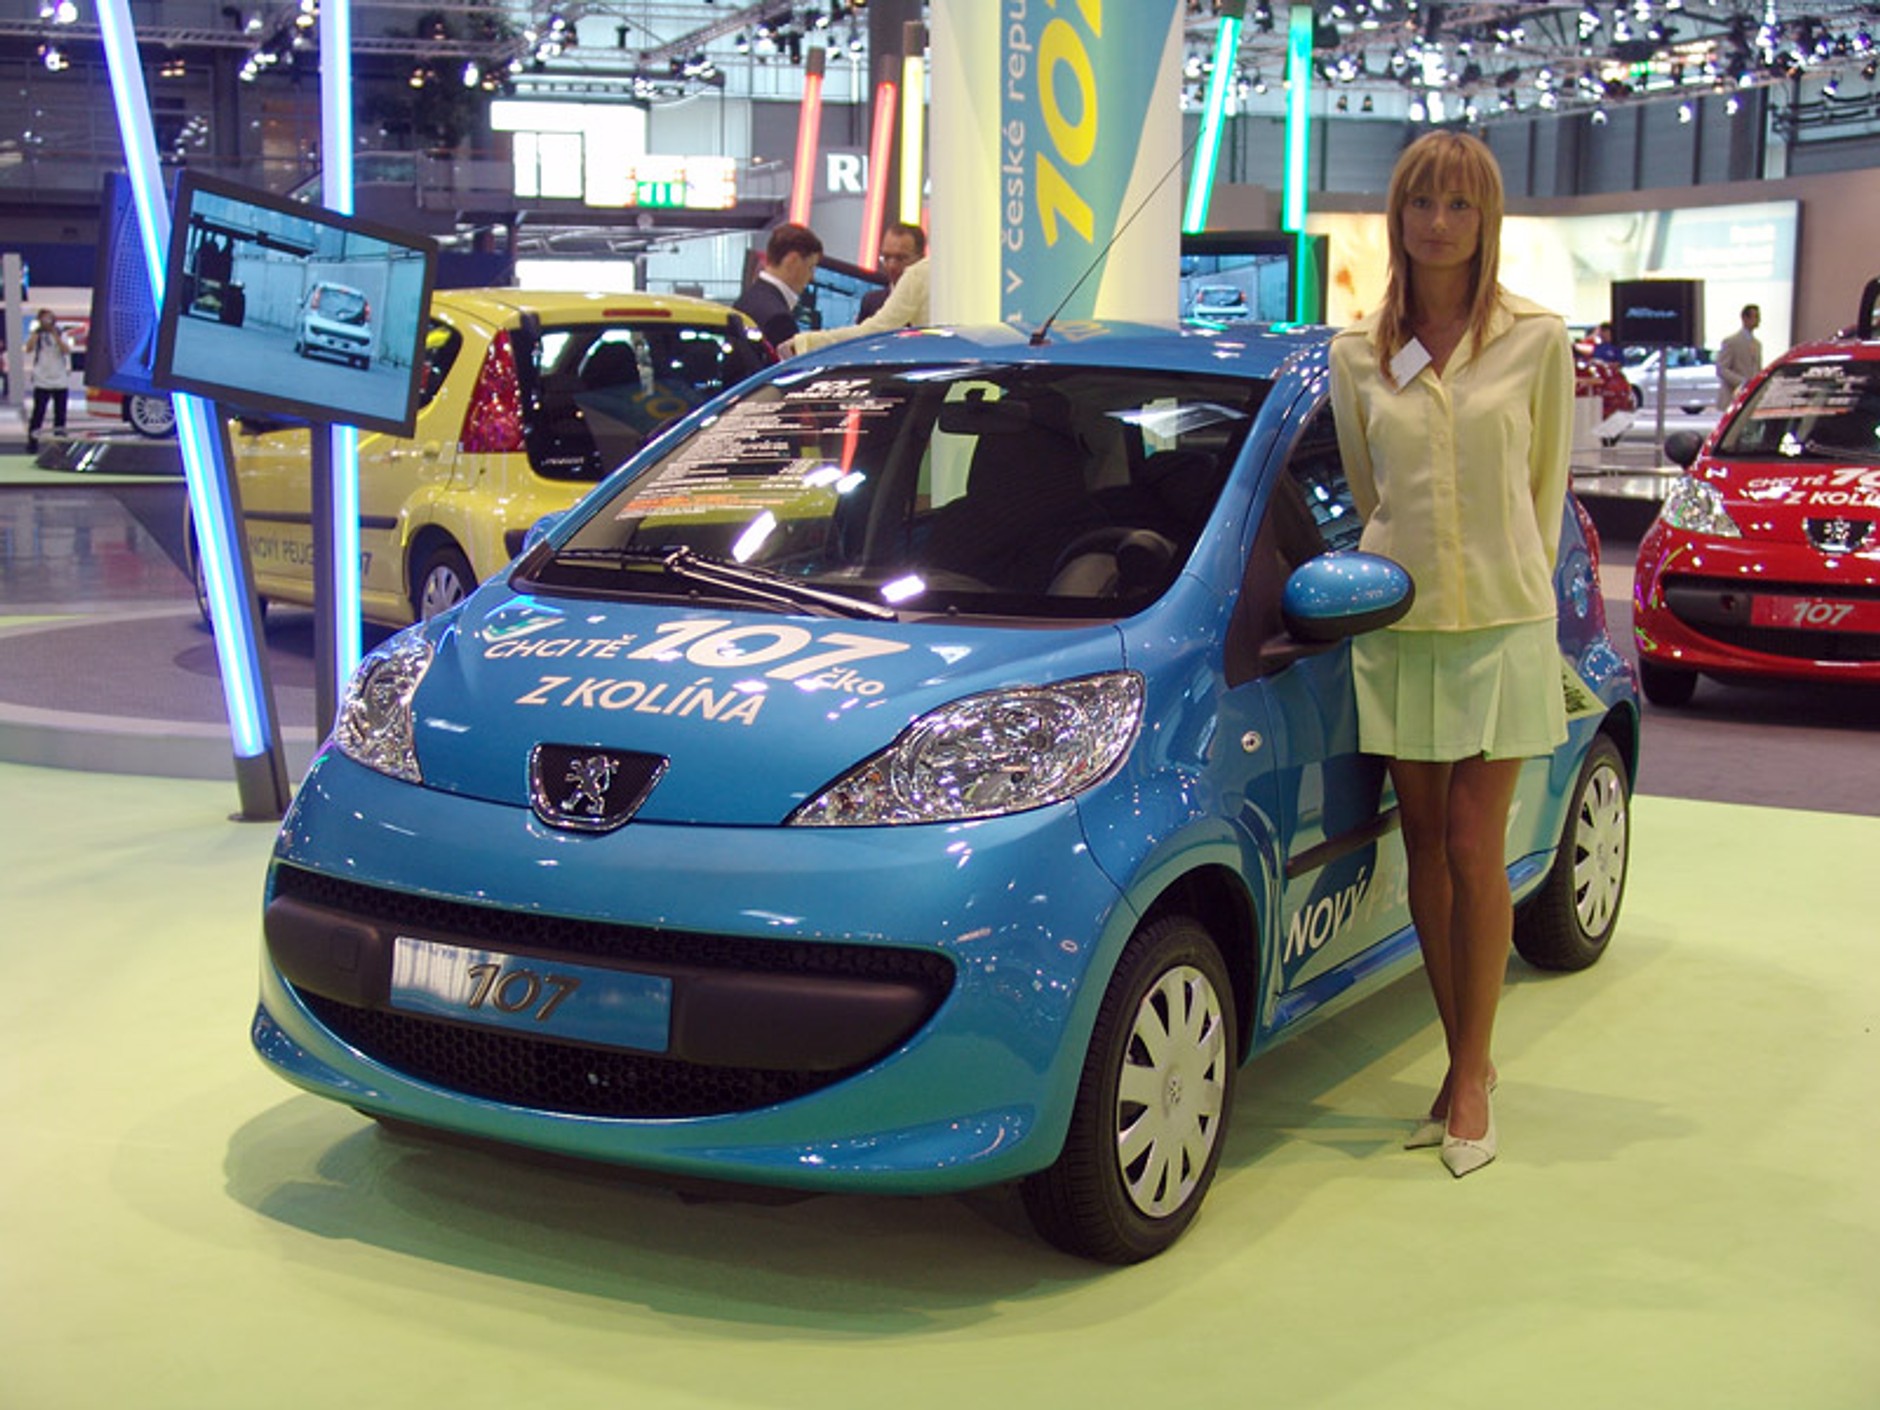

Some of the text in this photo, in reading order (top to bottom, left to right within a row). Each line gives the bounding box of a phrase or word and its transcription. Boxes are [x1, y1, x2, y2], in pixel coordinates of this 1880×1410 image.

[1036, 0, 1102, 247] 10
[1001, 119, 1024, 251] české
[1793, 601, 1855, 625] 107
[484, 639, 582, 659] CHCI
[576, 634, 638, 659] TĚ
[626, 619, 911, 680] 107
[515, 676, 766, 726] Z KOLÍNA
[1283, 864, 1367, 964] NOVÝ
[467, 964, 583, 1022] 107
